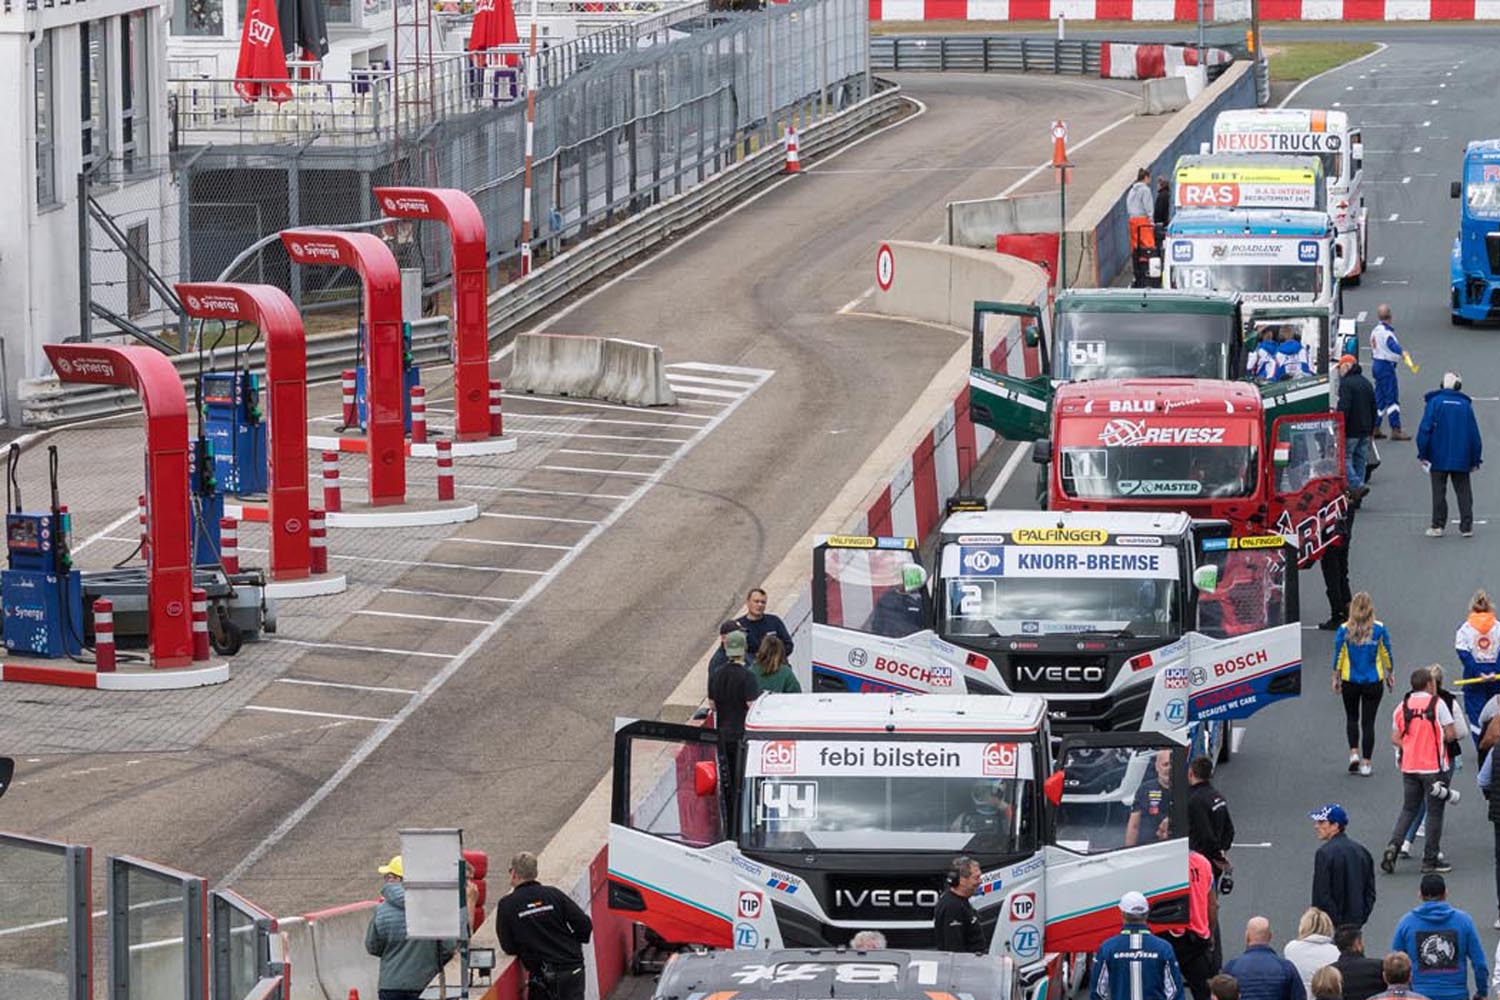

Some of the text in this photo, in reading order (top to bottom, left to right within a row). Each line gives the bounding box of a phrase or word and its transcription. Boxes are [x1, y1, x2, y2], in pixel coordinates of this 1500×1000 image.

[201, 297, 240, 314] Synergy
[72, 360, 115, 377] Synergy
[1109, 400, 1155, 412] BALU
[1145, 427, 1226, 443] REVESZ
[1154, 482, 1198, 492] MASTER
[1018, 530, 1102, 542] PALFINGER
[1242, 538, 1283, 546] PALFINGER
[1018, 554, 1160, 570] KNORR-BREMSE
[960, 584, 982, 613] 2
[15, 605, 44, 621] Synergy
[875, 657, 931, 682] BOSCH
[1214, 650, 1268, 677] BOSCH
[1017, 666, 1102, 681] IVECO
[1198, 705, 1227, 719] BECAUSE
[1239, 696, 1257, 708] CARE
[820, 748, 960, 767] febi bilstein
[742, 900, 759, 912] TIP
[836, 890, 939, 907] IVECO
[1014, 901, 1032, 913] TIP
[1014, 933, 1037, 950] ZF
